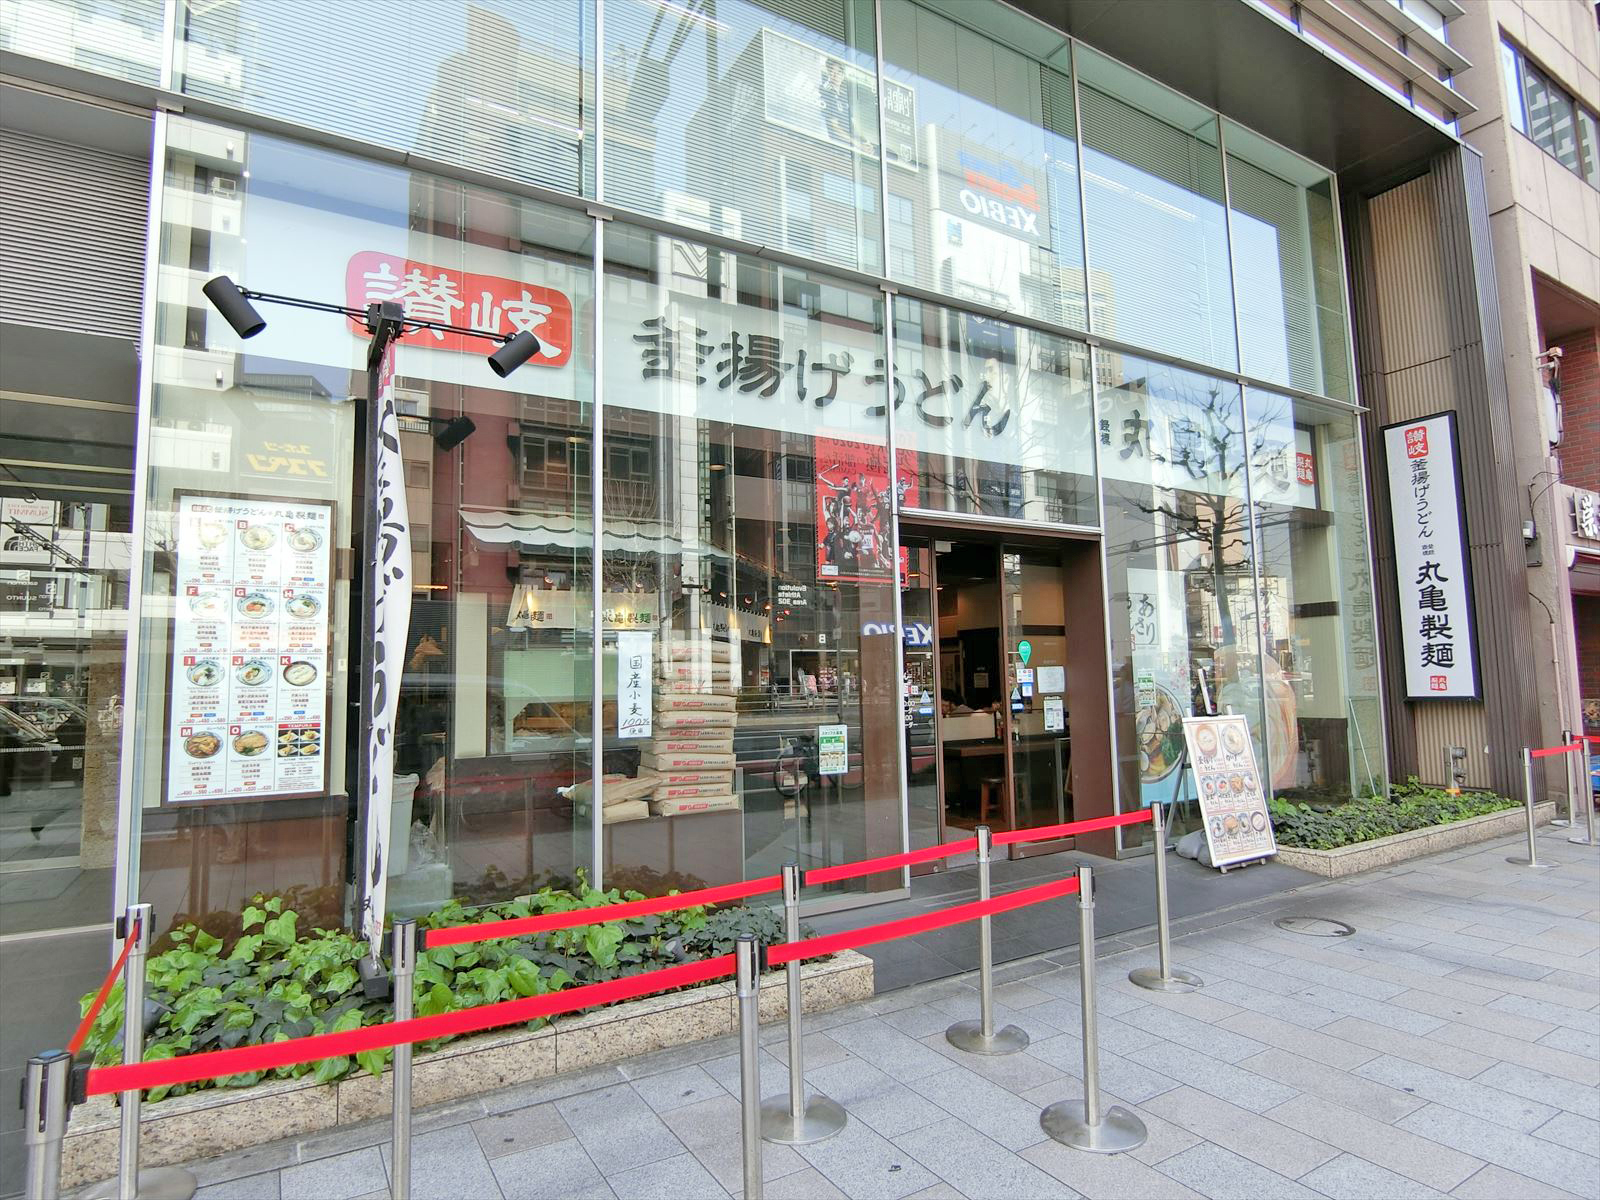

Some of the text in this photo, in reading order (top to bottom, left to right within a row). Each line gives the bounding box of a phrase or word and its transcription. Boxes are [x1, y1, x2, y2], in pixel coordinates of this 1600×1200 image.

[632, 316, 1011, 437] 釜揚げうどん
[1406, 428, 1428, 456] 讃岐
[1409, 458, 1434, 539] 釜揚げうどん
[1415, 560, 1456, 669] 丸亀製麺
[626, 655, 643, 717] 国産小麦
[622, 717, 650, 727] 100%
